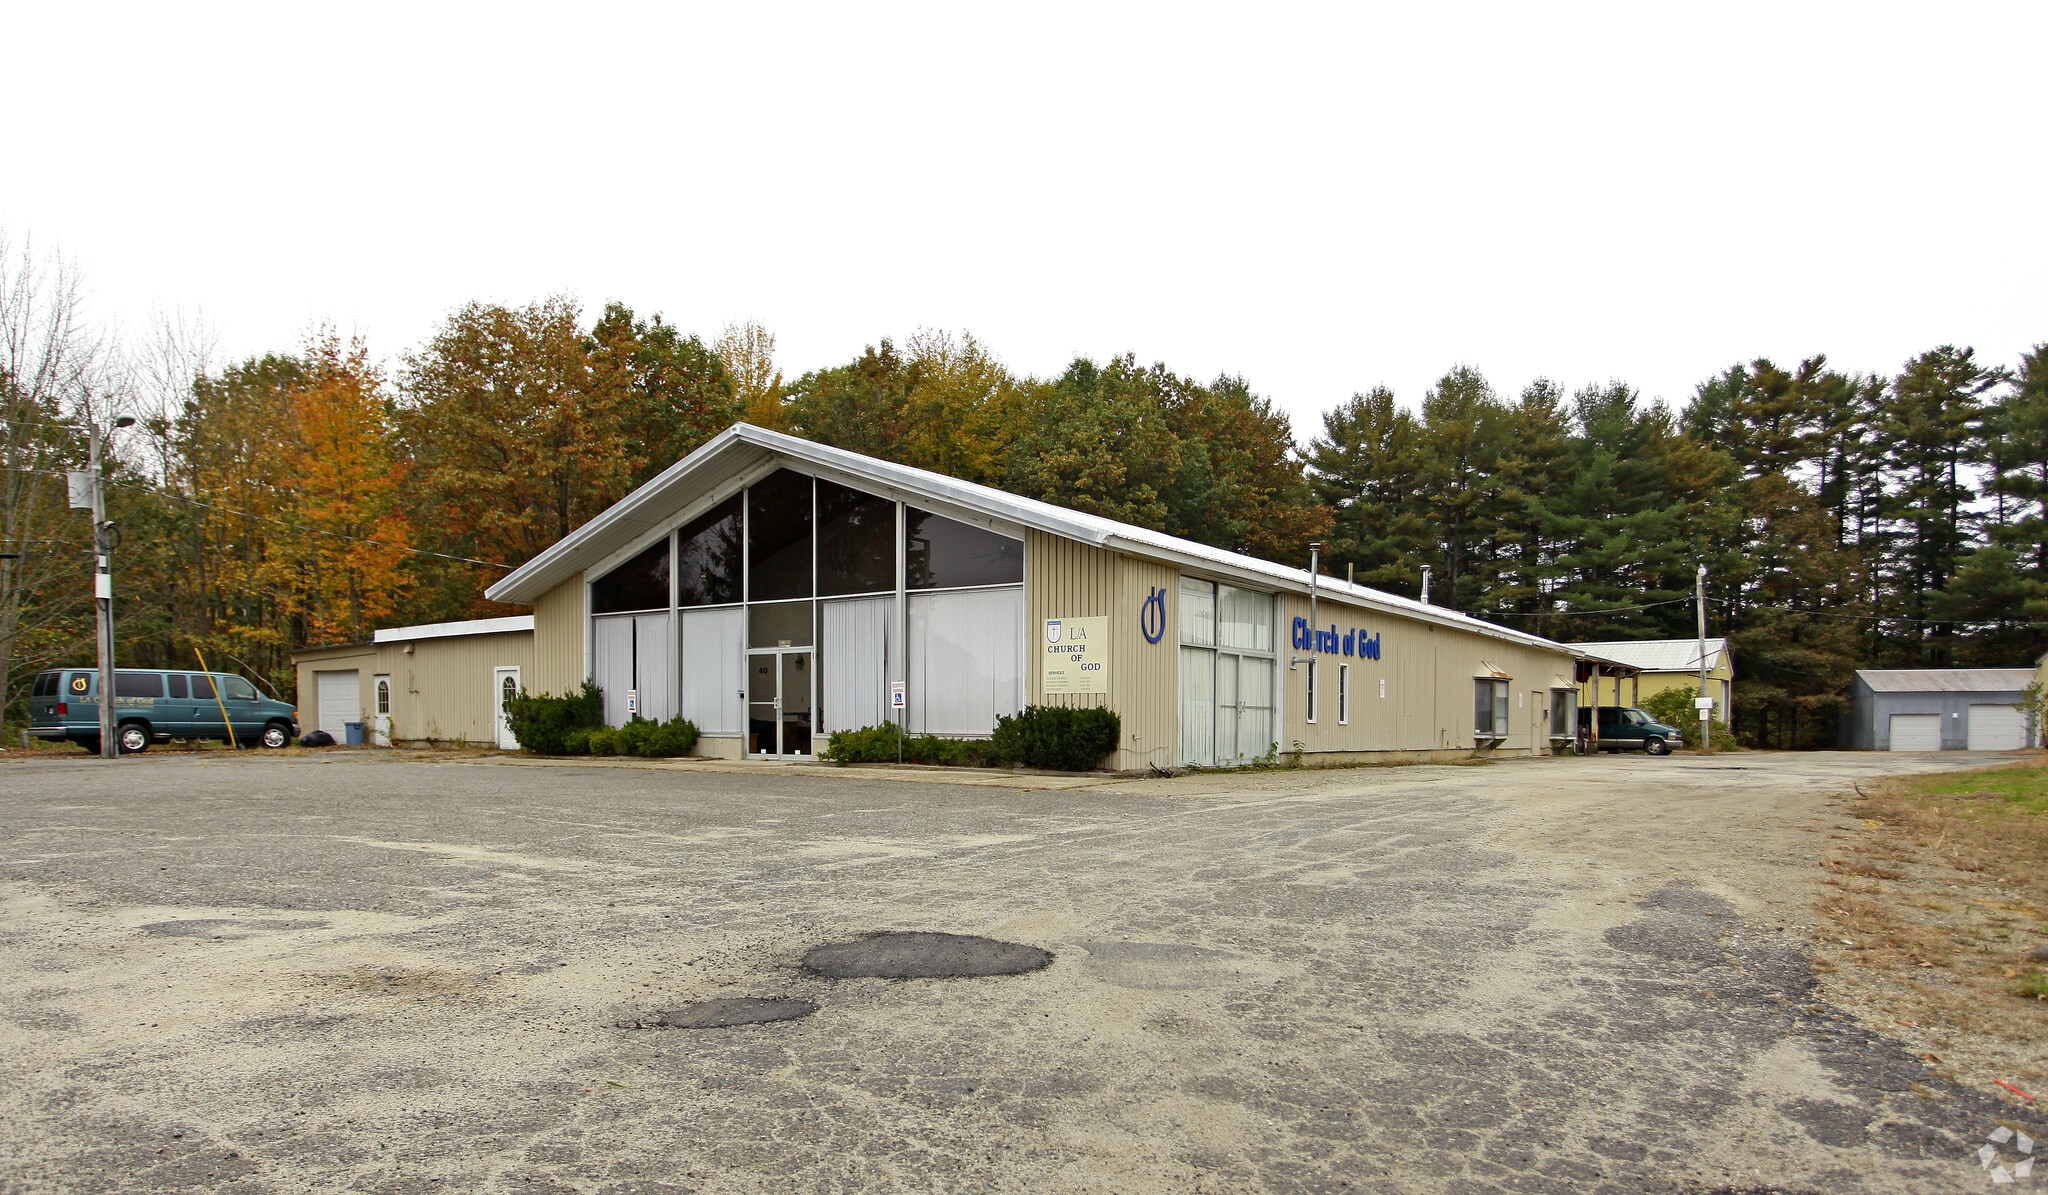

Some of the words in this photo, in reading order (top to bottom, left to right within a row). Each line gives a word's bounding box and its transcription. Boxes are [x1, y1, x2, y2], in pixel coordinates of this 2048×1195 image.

[1343, 628, 1355, 656] of
[1359, 628, 1380, 660] God
[1047, 645, 1086, 653] CHURCH
[1071, 654, 1083, 662] OF
[1081, 663, 1101, 671] GOD
